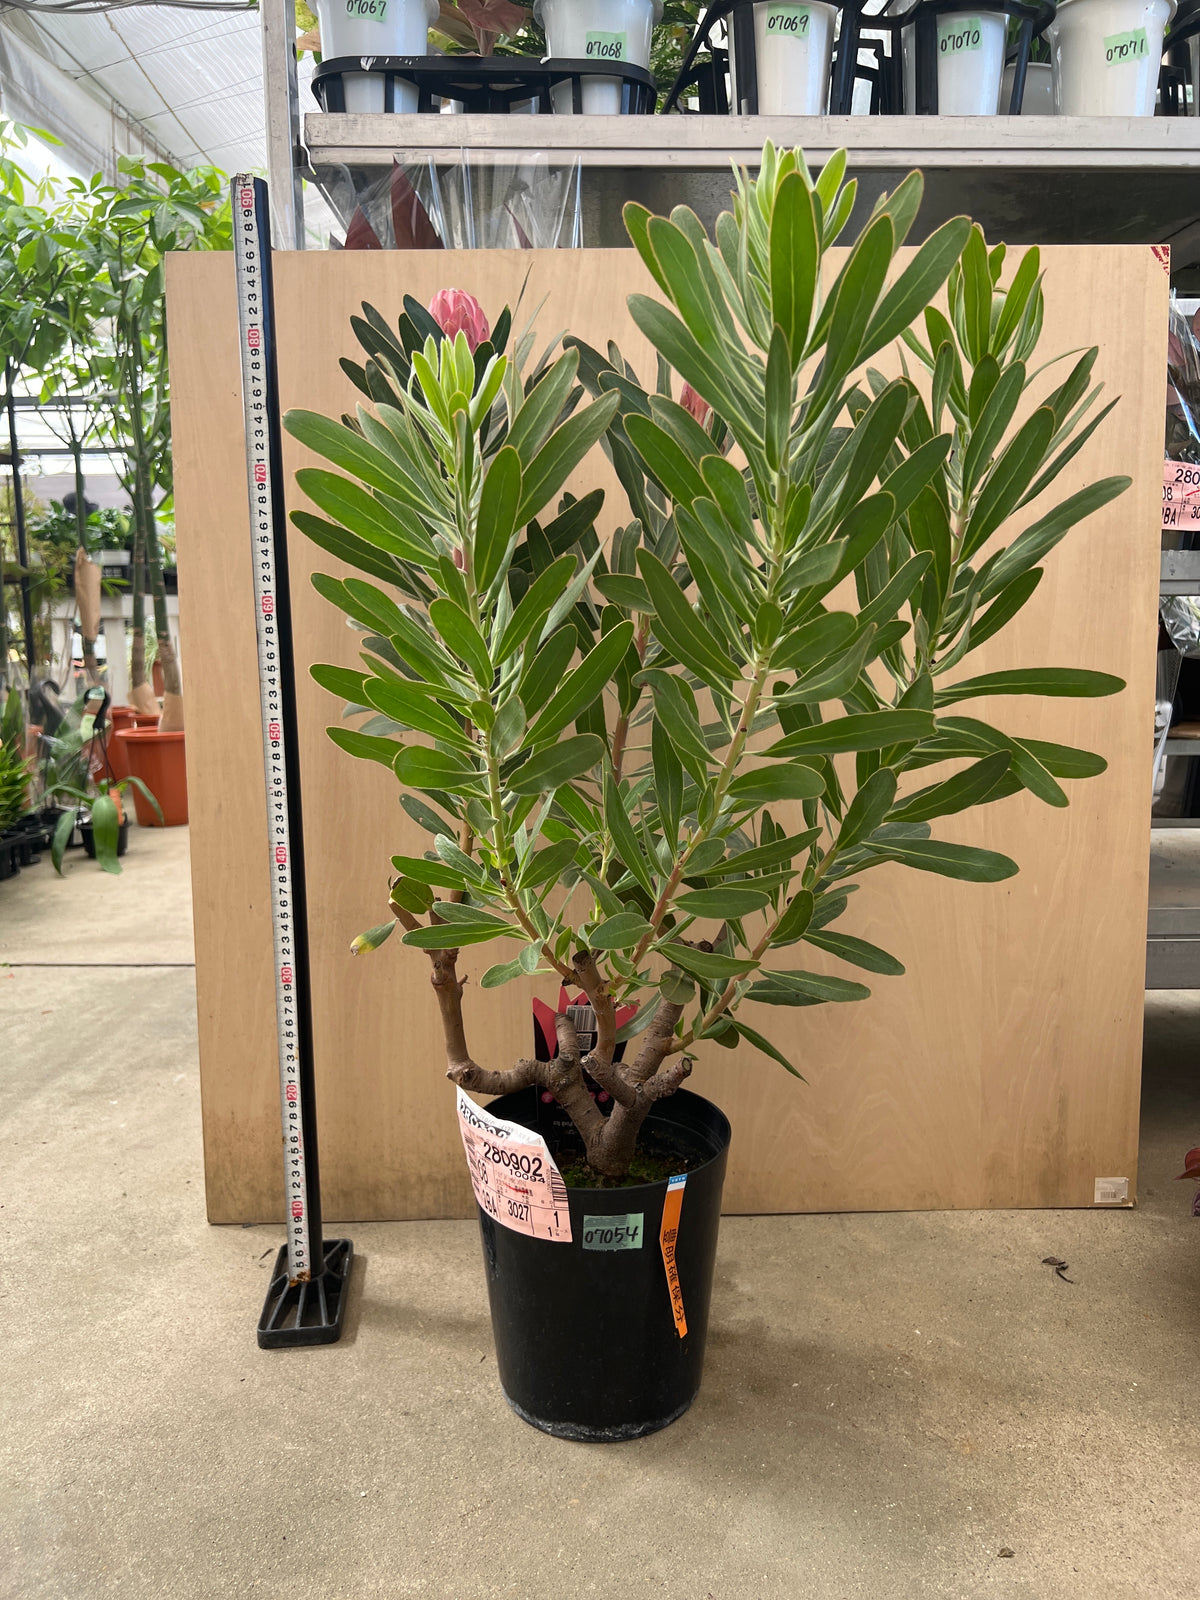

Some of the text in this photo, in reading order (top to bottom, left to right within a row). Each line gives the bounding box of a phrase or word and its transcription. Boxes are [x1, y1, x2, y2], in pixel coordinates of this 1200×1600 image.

[346, 0, 387, 16] 07067
[768, 14, 809, 32] 07069
[940, 29, 980, 52] 07070
[586, 41, 622, 58] 07068
[1106, 38, 1144, 61] 07071
[242, 190, 252, 207] 90
[243, 209, 253, 218] 9
[244, 223, 254, 232] 8
[244, 237, 254, 246] 7
[245, 251, 255, 260] 6
[246, 265, 256, 273] 5
[247, 279, 256, 288] 4
[247, 293, 257, 301] 3
[248, 307, 258, 315] 2
[250, 330, 258, 345] 80
[250, 348, 260, 356] 9
[251, 361, 260, 370] 8
[252, 375, 261, 383] 7
[252, 389, 262, 397] 6
[253, 402, 262, 410] 5
[254, 416, 263, 424] 4
[254, 429, 264, 437] 3
[257, 466, 265, 480] 70
[257, 482, 266, 491] 9
[258, 496, 267, 504] 8
[258, 509, 267, 517] 7
[1162, 507, 1176, 525] BA
[259, 522, 268, 530] 6
[260, 535, 269, 543] 5
[260, 549, 269, 557] 4
[261, 562, 270, 570] 3
[264, 597, 272, 612] 60
[264, 613, 273, 621] 9
[265, 626, 274, 634] 8
[266, 639, 274, 647] 7
[266, 652, 275, 660] 6
[268, 690, 277, 698] 3
[271, 725, 279, 738] 50
[271, 740, 280, 748] 9
[272, 765, 281, 773] 7
[274, 802, 283, 810] 4
[277, 848, 285, 862] 40
[283, 968, 291, 982] 30
[284, 995, 292, 1003] 8
[286, 1054, 295, 1062] 3
[288, 1086, 296, 1099] 20
[483, 1141, 543, 1177] 280902
[509, 1168, 546, 1184] 10094
[293, 1202, 302, 1215] 10
[508, 1199, 529, 1222] 3027
[293, 1215, 303, 1223] 9
[553, 1210, 560, 1228] 1
[294, 1227, 303, 1235] 8
[547, 1226, 553, 1238] 1
[584, 1226, 639, 1244] 07054
